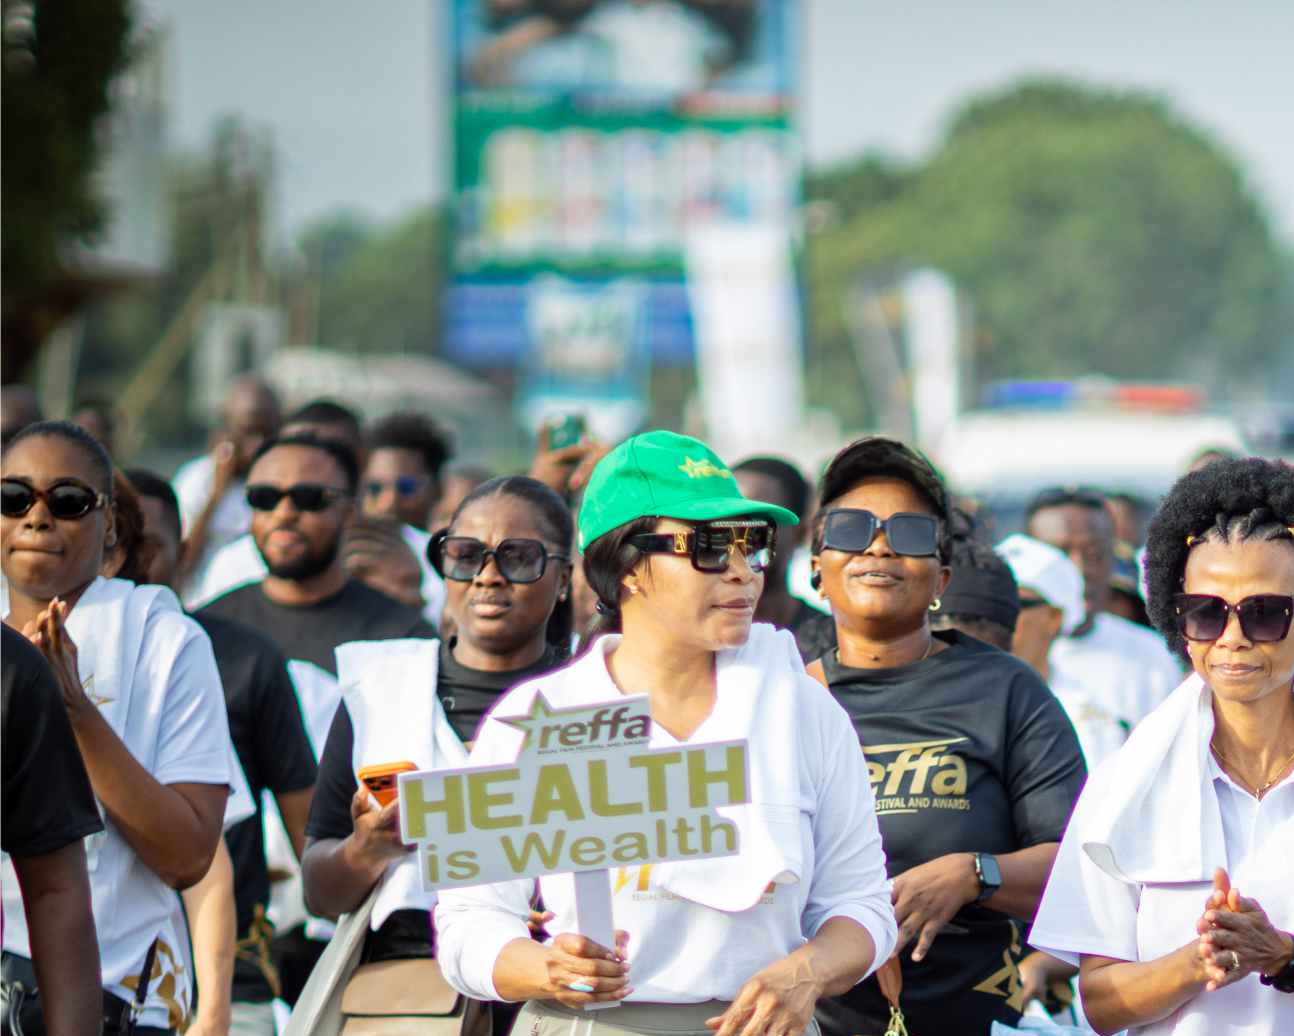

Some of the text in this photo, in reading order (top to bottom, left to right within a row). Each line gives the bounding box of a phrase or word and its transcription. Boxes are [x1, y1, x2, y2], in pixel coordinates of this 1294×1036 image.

[539, 706, 653, 749] reffa
[403, 745, 747, 840] HEALTH
[866, 746, 968, 796] effa
[875, 797, 906, 810] STIVAL
[423, 814, 738, 884] is Wealth
